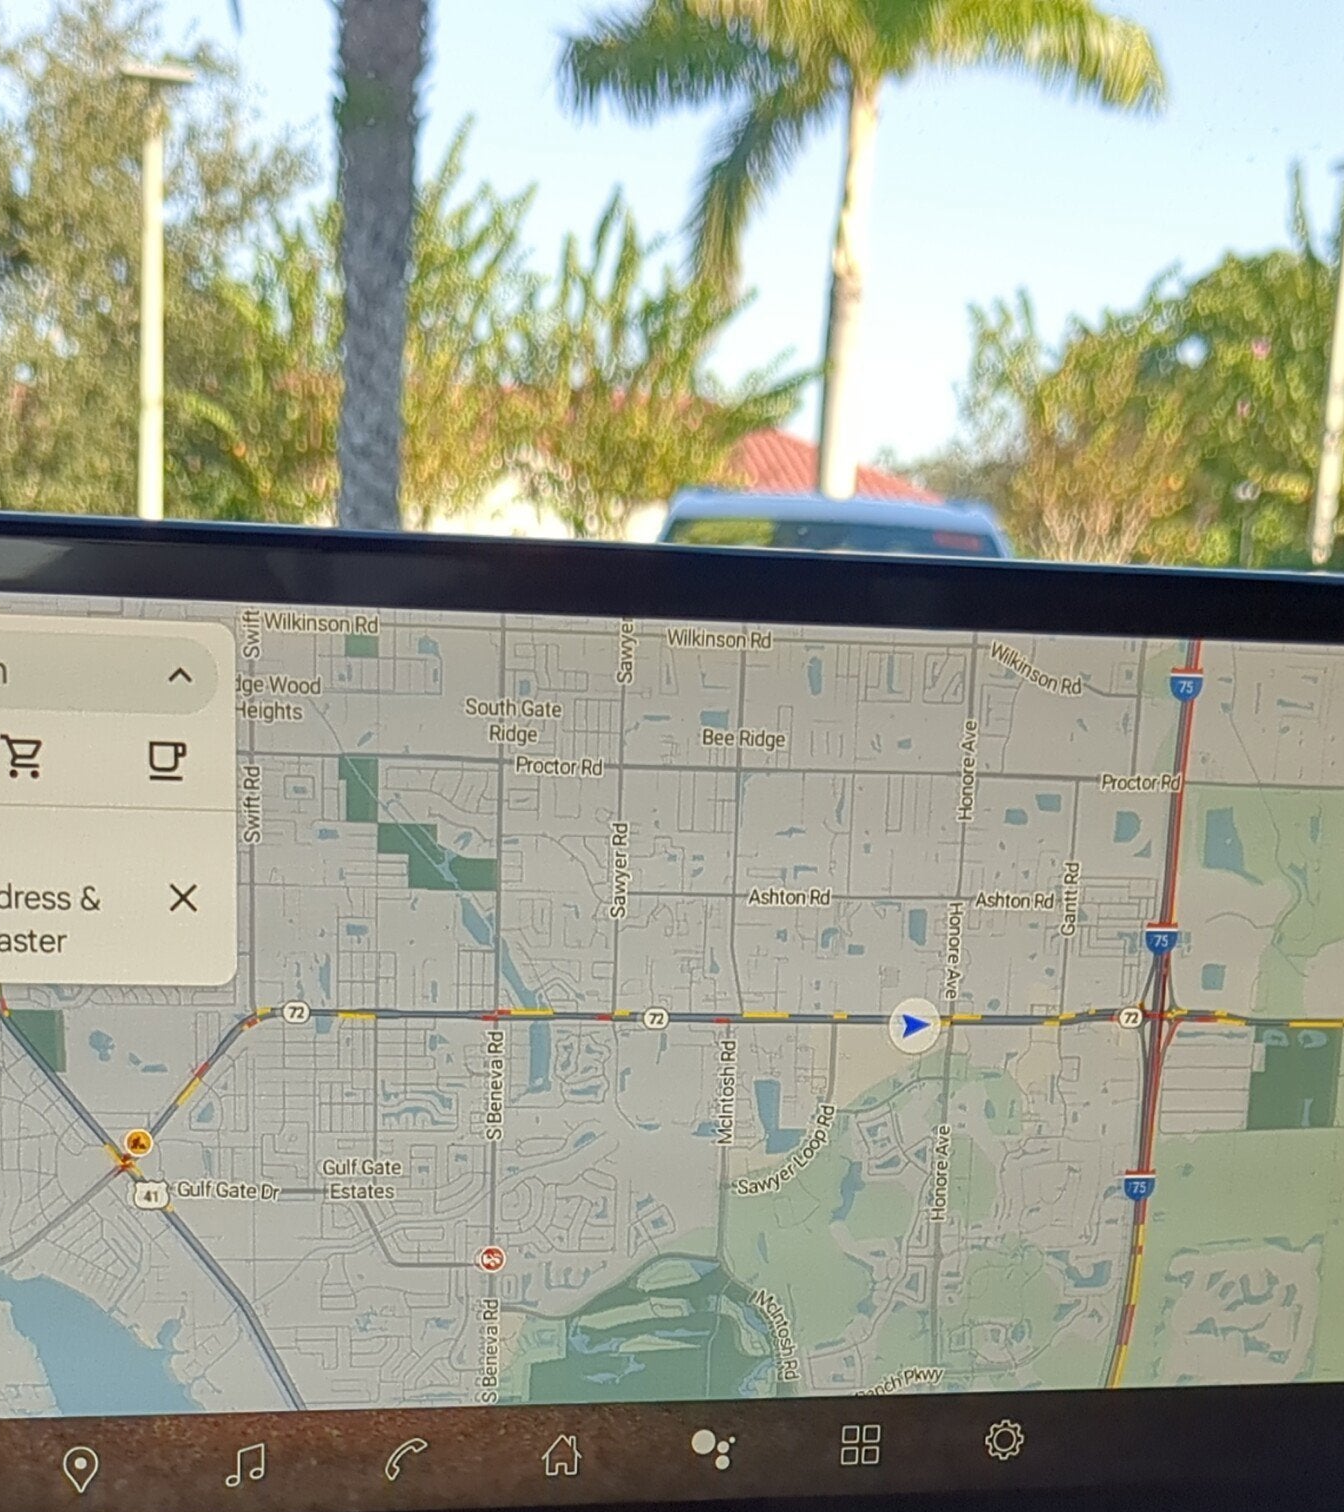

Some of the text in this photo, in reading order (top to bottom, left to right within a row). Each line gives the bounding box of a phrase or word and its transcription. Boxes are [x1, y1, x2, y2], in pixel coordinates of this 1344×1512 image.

[263, 612, 378, 633] Wilkinson Rd
[243, 610, 260, 658] Swift
[667, 629, 772, 649] Wilkinson Rd
[990, 641, 1082, 695] Wilkinson Rd
[269, 676, 321, 695] Wood
[1178, 680, 1194, 693] 75
[465, 698, 562, 717] South Gate
[490, 724, 538, 745] Ridge
[702, 729, 786, 751] Bee Ridge
[516, 756, 603, 776] Proctor Rd
[957, 720, 978, 821] Honore Ave
[1101, 774, 1181, 791] Proctor Rd
[243, 766, 261, 843] Swift Rd
[610, 822, 629, 918] Sawyer Rd
[80, 886, 101, 911] &
[749, 888, 830, 906] Ashton Rd
[975, 891, 1054, 908] Ashton Rd
[1061, 862, 1080, 936] Gantt Rd
[946, 902, 964, 999] Honore Ave
[1154, 935, 1169, 948] 75
[289, 1006, 304, 1019] 72
[649, 1013, 664, 1025] 72
[1123, 1013, 1138, 1025] 72
[487, 1031, 505, 1141] S Beneva Rd
[718, 1040, 737, 1145] McIntosh Rd
[738, 1104, 836, 1194] Sawyer Loop Rd
[322, 1159, 401, 1176] Gulf Gate
[931, 1125, 951, 1221] Honore Ave
[143, 1191, 159, 1203] 41
[177, 1180, 280, 1200] Gulf Gate Dr
[330, 1182, 395, 1200] Estates
[1131, 1181, 1147, 1194] 75
[756, 1290, 799, 1381] McIntosh Rd
[481, 1299, 499, 1403] S Beneva Rd
[904, 1368, 944, 1385] Pkwy
